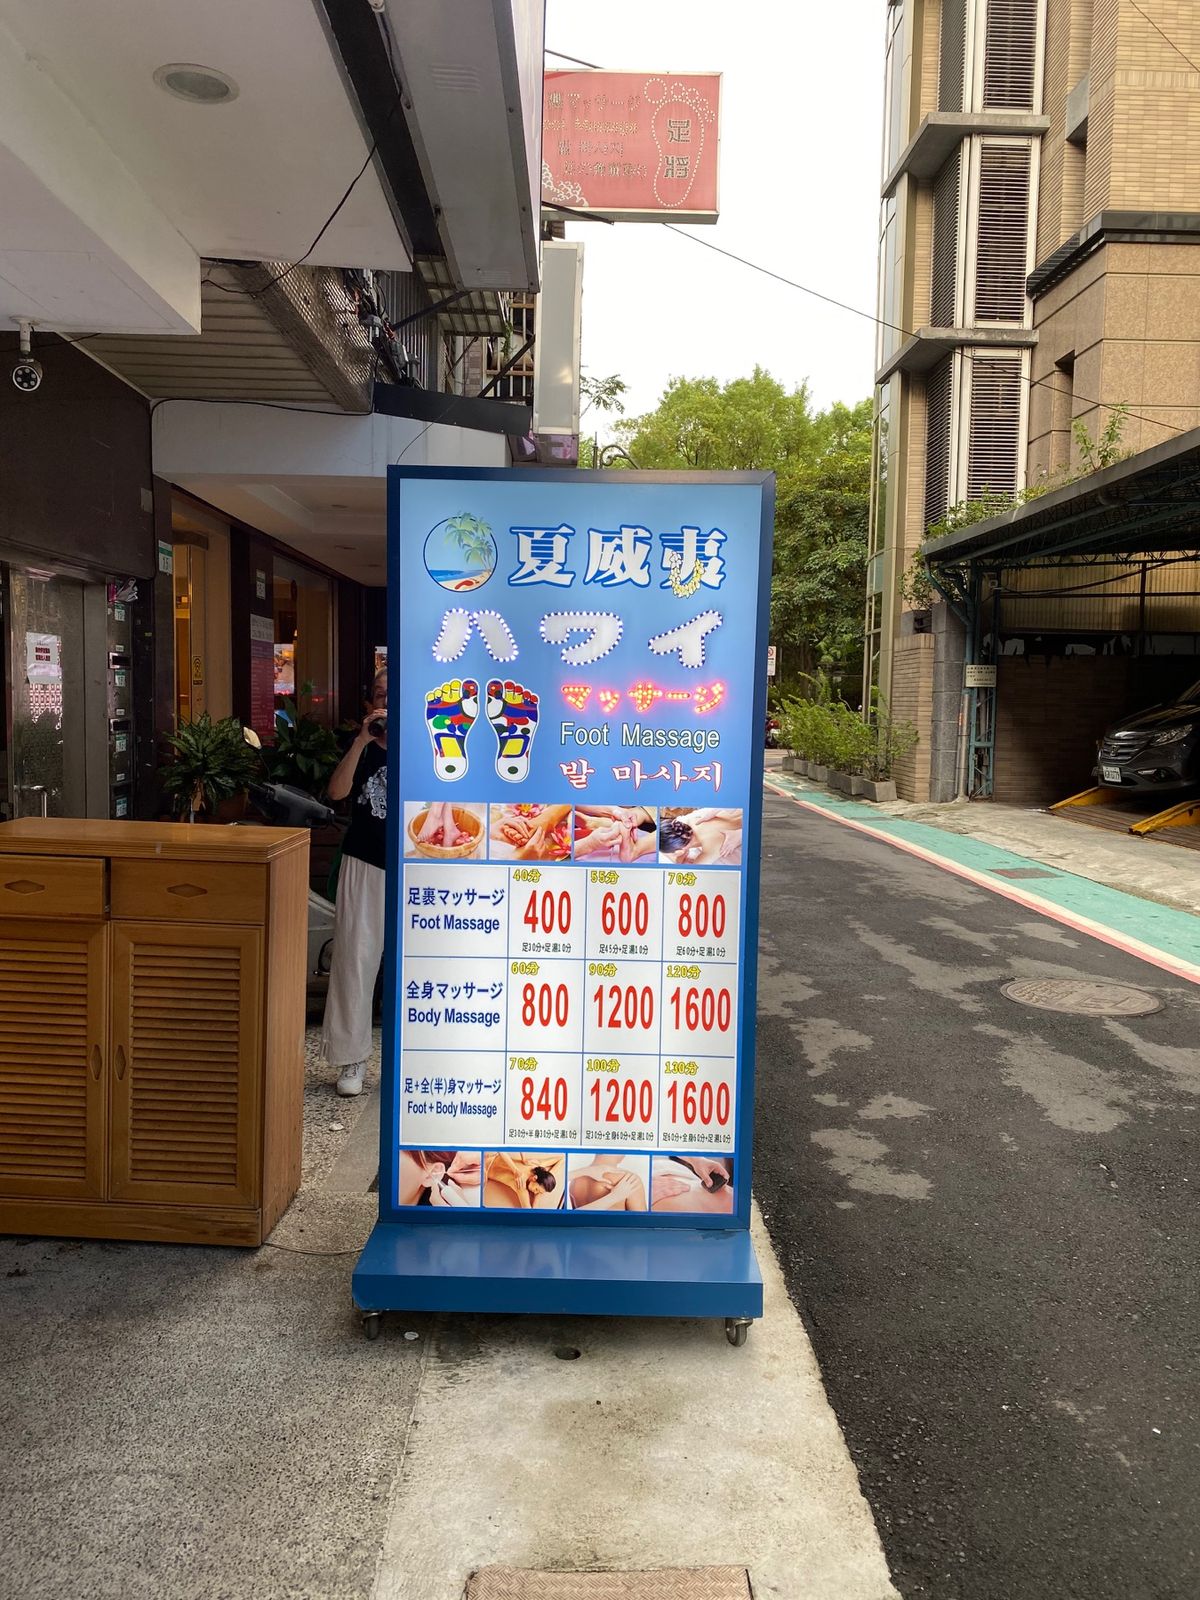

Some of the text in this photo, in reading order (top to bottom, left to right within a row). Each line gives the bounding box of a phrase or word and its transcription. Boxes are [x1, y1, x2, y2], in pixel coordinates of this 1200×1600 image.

[509, 523, 727, 590] 夏威夷
[432, 608, 723, 668] ハワイ
[562, 683, 724, 713] マッサージ
[560, 722, 720, 753] Foot Massage
[559, 759, 723, 791] 발 마사지
[513, 869, 541, 883] 40分
[590, 870, 619, 885] 55分
[668, 872, 696, 886] 70分
[408, 887, 505, 906] 足裏マッサージ
[412, 914, 500, 934] Foot Massage
[523, 890, 571, 934] 400
[602, 891, 648, 936] 600
[678, 893, 726, 938] 800
[511, 962, 539, 975] 60分
[589, 963, 617, 977] 90分
[667, 965, 701, 980] 120分
[406, 981, 503, 1000] 全身マッサージ
[522, 982, 569, 1027] 800
[593, 984, 652, 1030] 1200
[670, 986, 730, 1032] 1600
[408, 1008, 500, 1028] Body Massage
[509, 1057, 537, 1071] 70分
[586, 1058, 620, 1073] 100分
[664, 1060, 699, 1075] 130分
[407, 1101, 427, 1114] Foot
[436, 1101, 458, 1117] Body
[460, 1102, 498, 1118] Massage
[520, 1076, 568, 1121] 840
[590, 1077, 651, 1124] 1200
[667, 1081, 730, 1126] 1600
